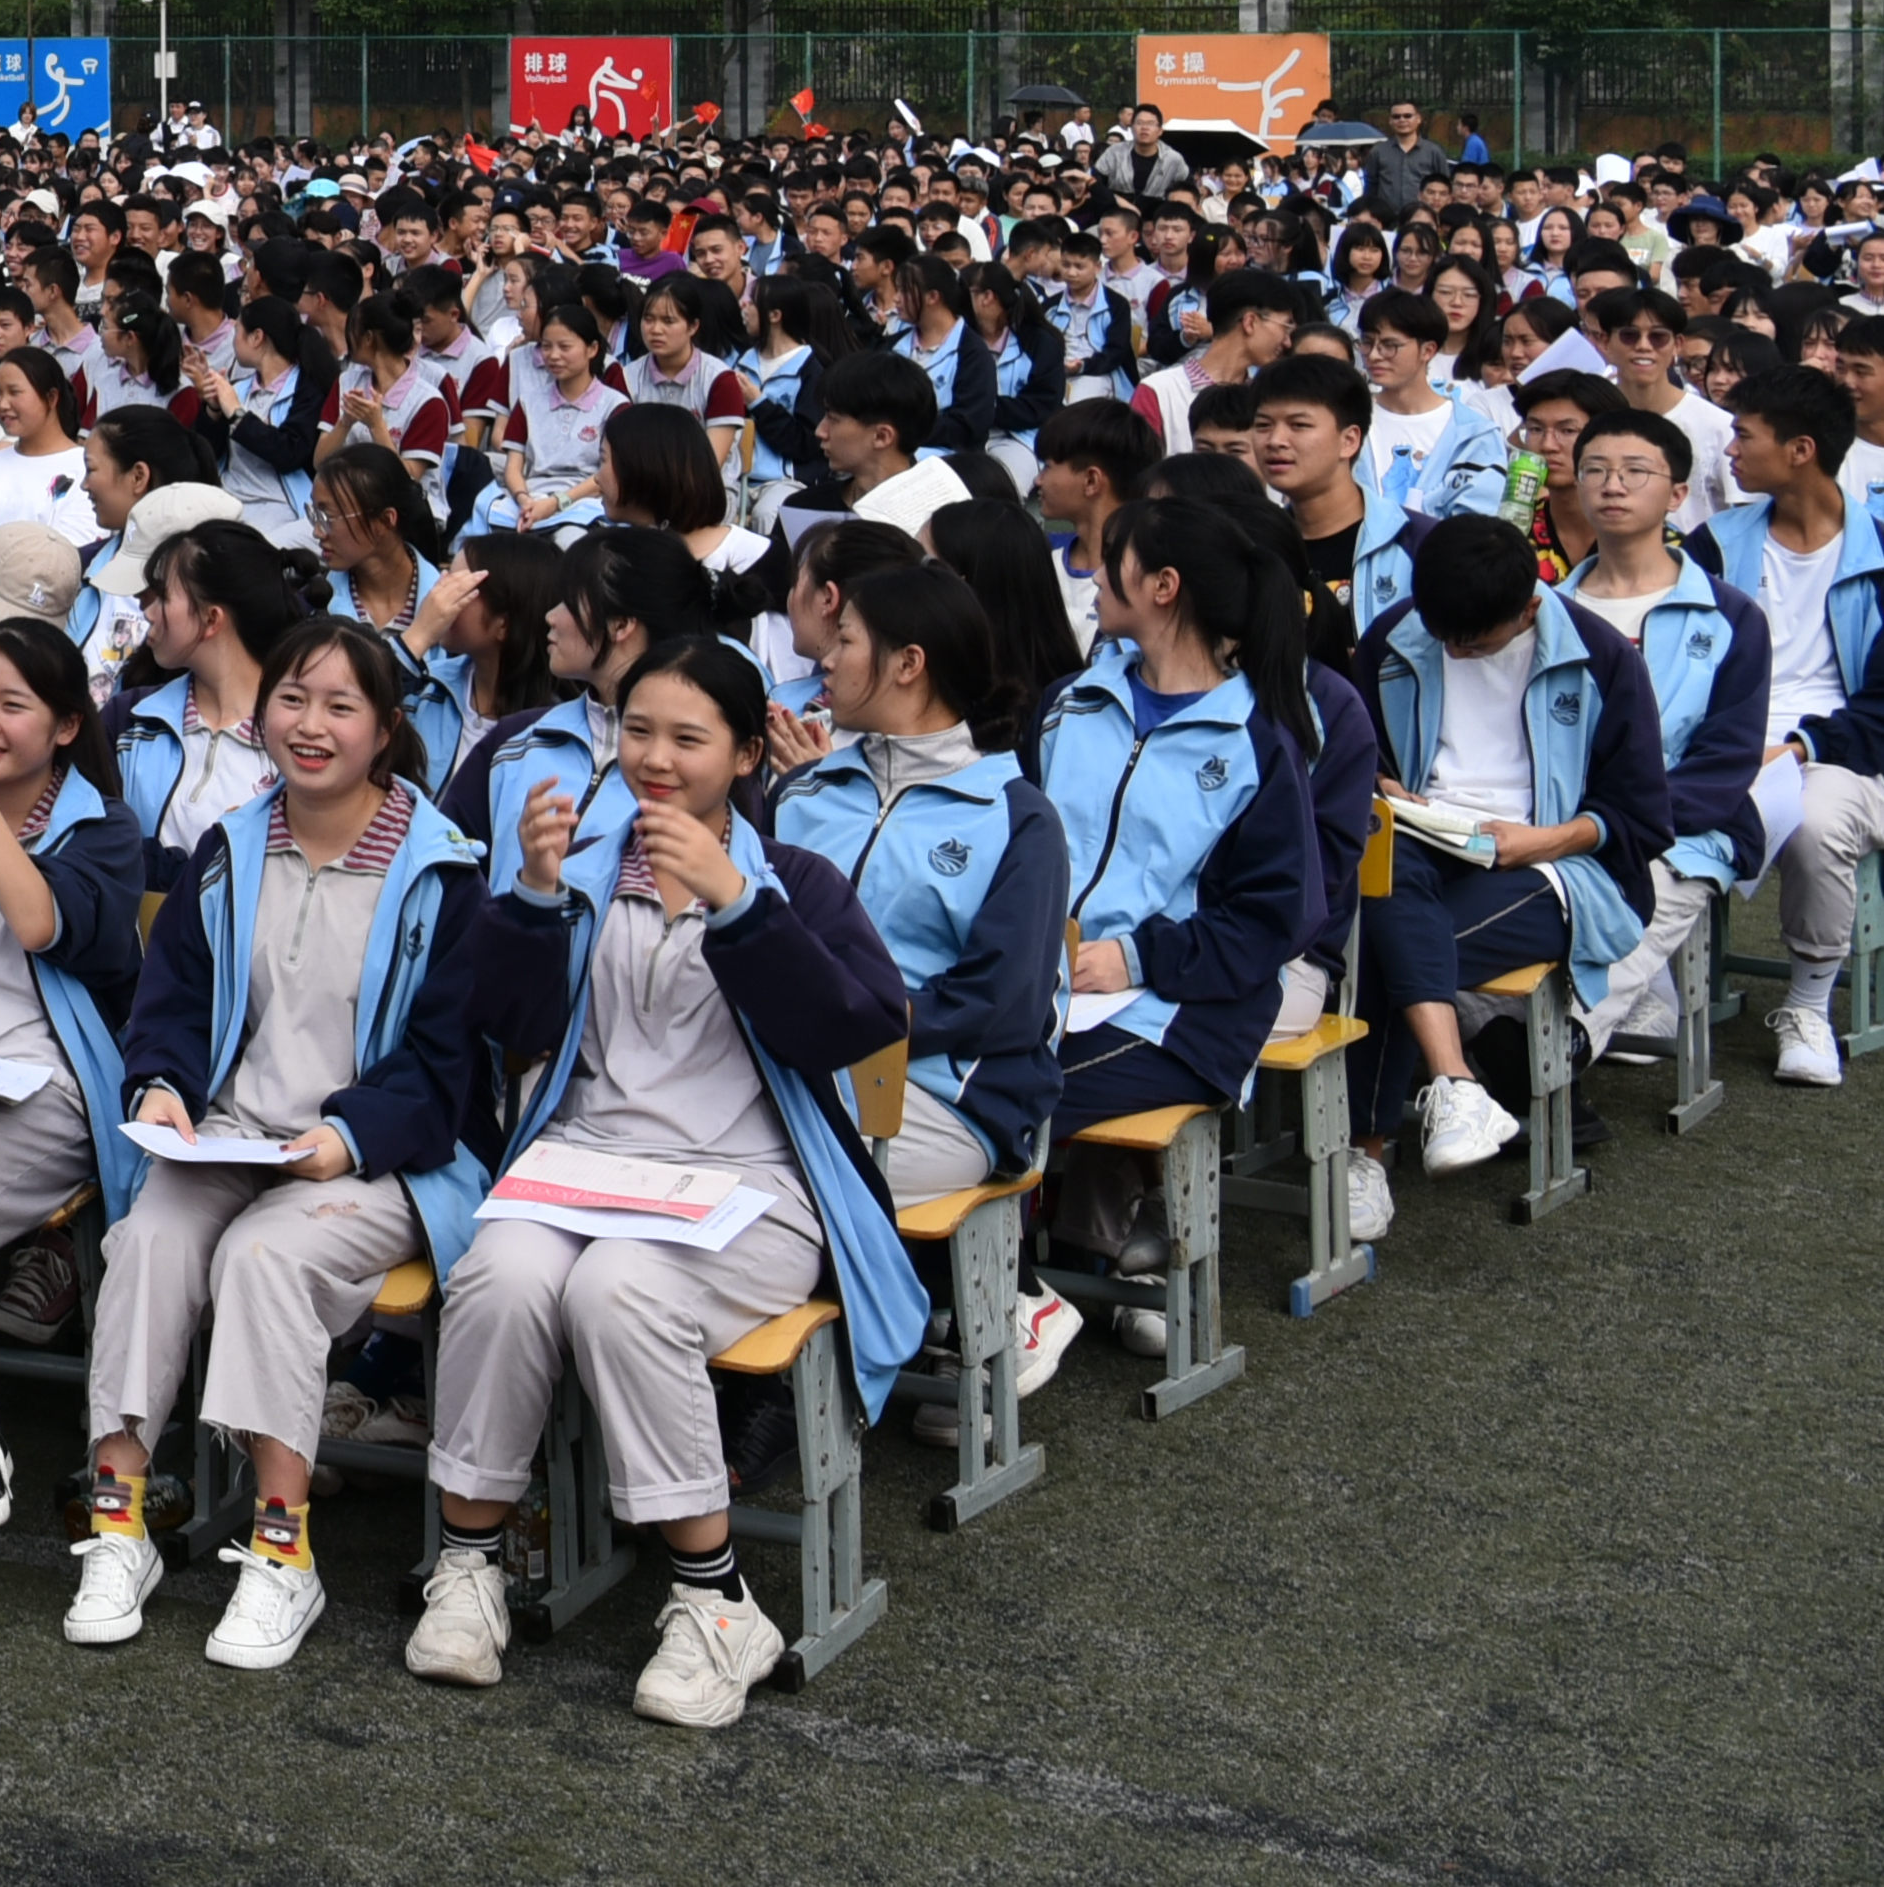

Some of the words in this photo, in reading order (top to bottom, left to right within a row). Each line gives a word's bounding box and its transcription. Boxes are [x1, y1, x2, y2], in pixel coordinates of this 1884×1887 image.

[524, 52, 567, 72] 排球
[1155, 52, 1205, 73] 体操
[524, 74, 567, 85] Volleyball
[1155, 75, 1217, 87] Gymnastics
